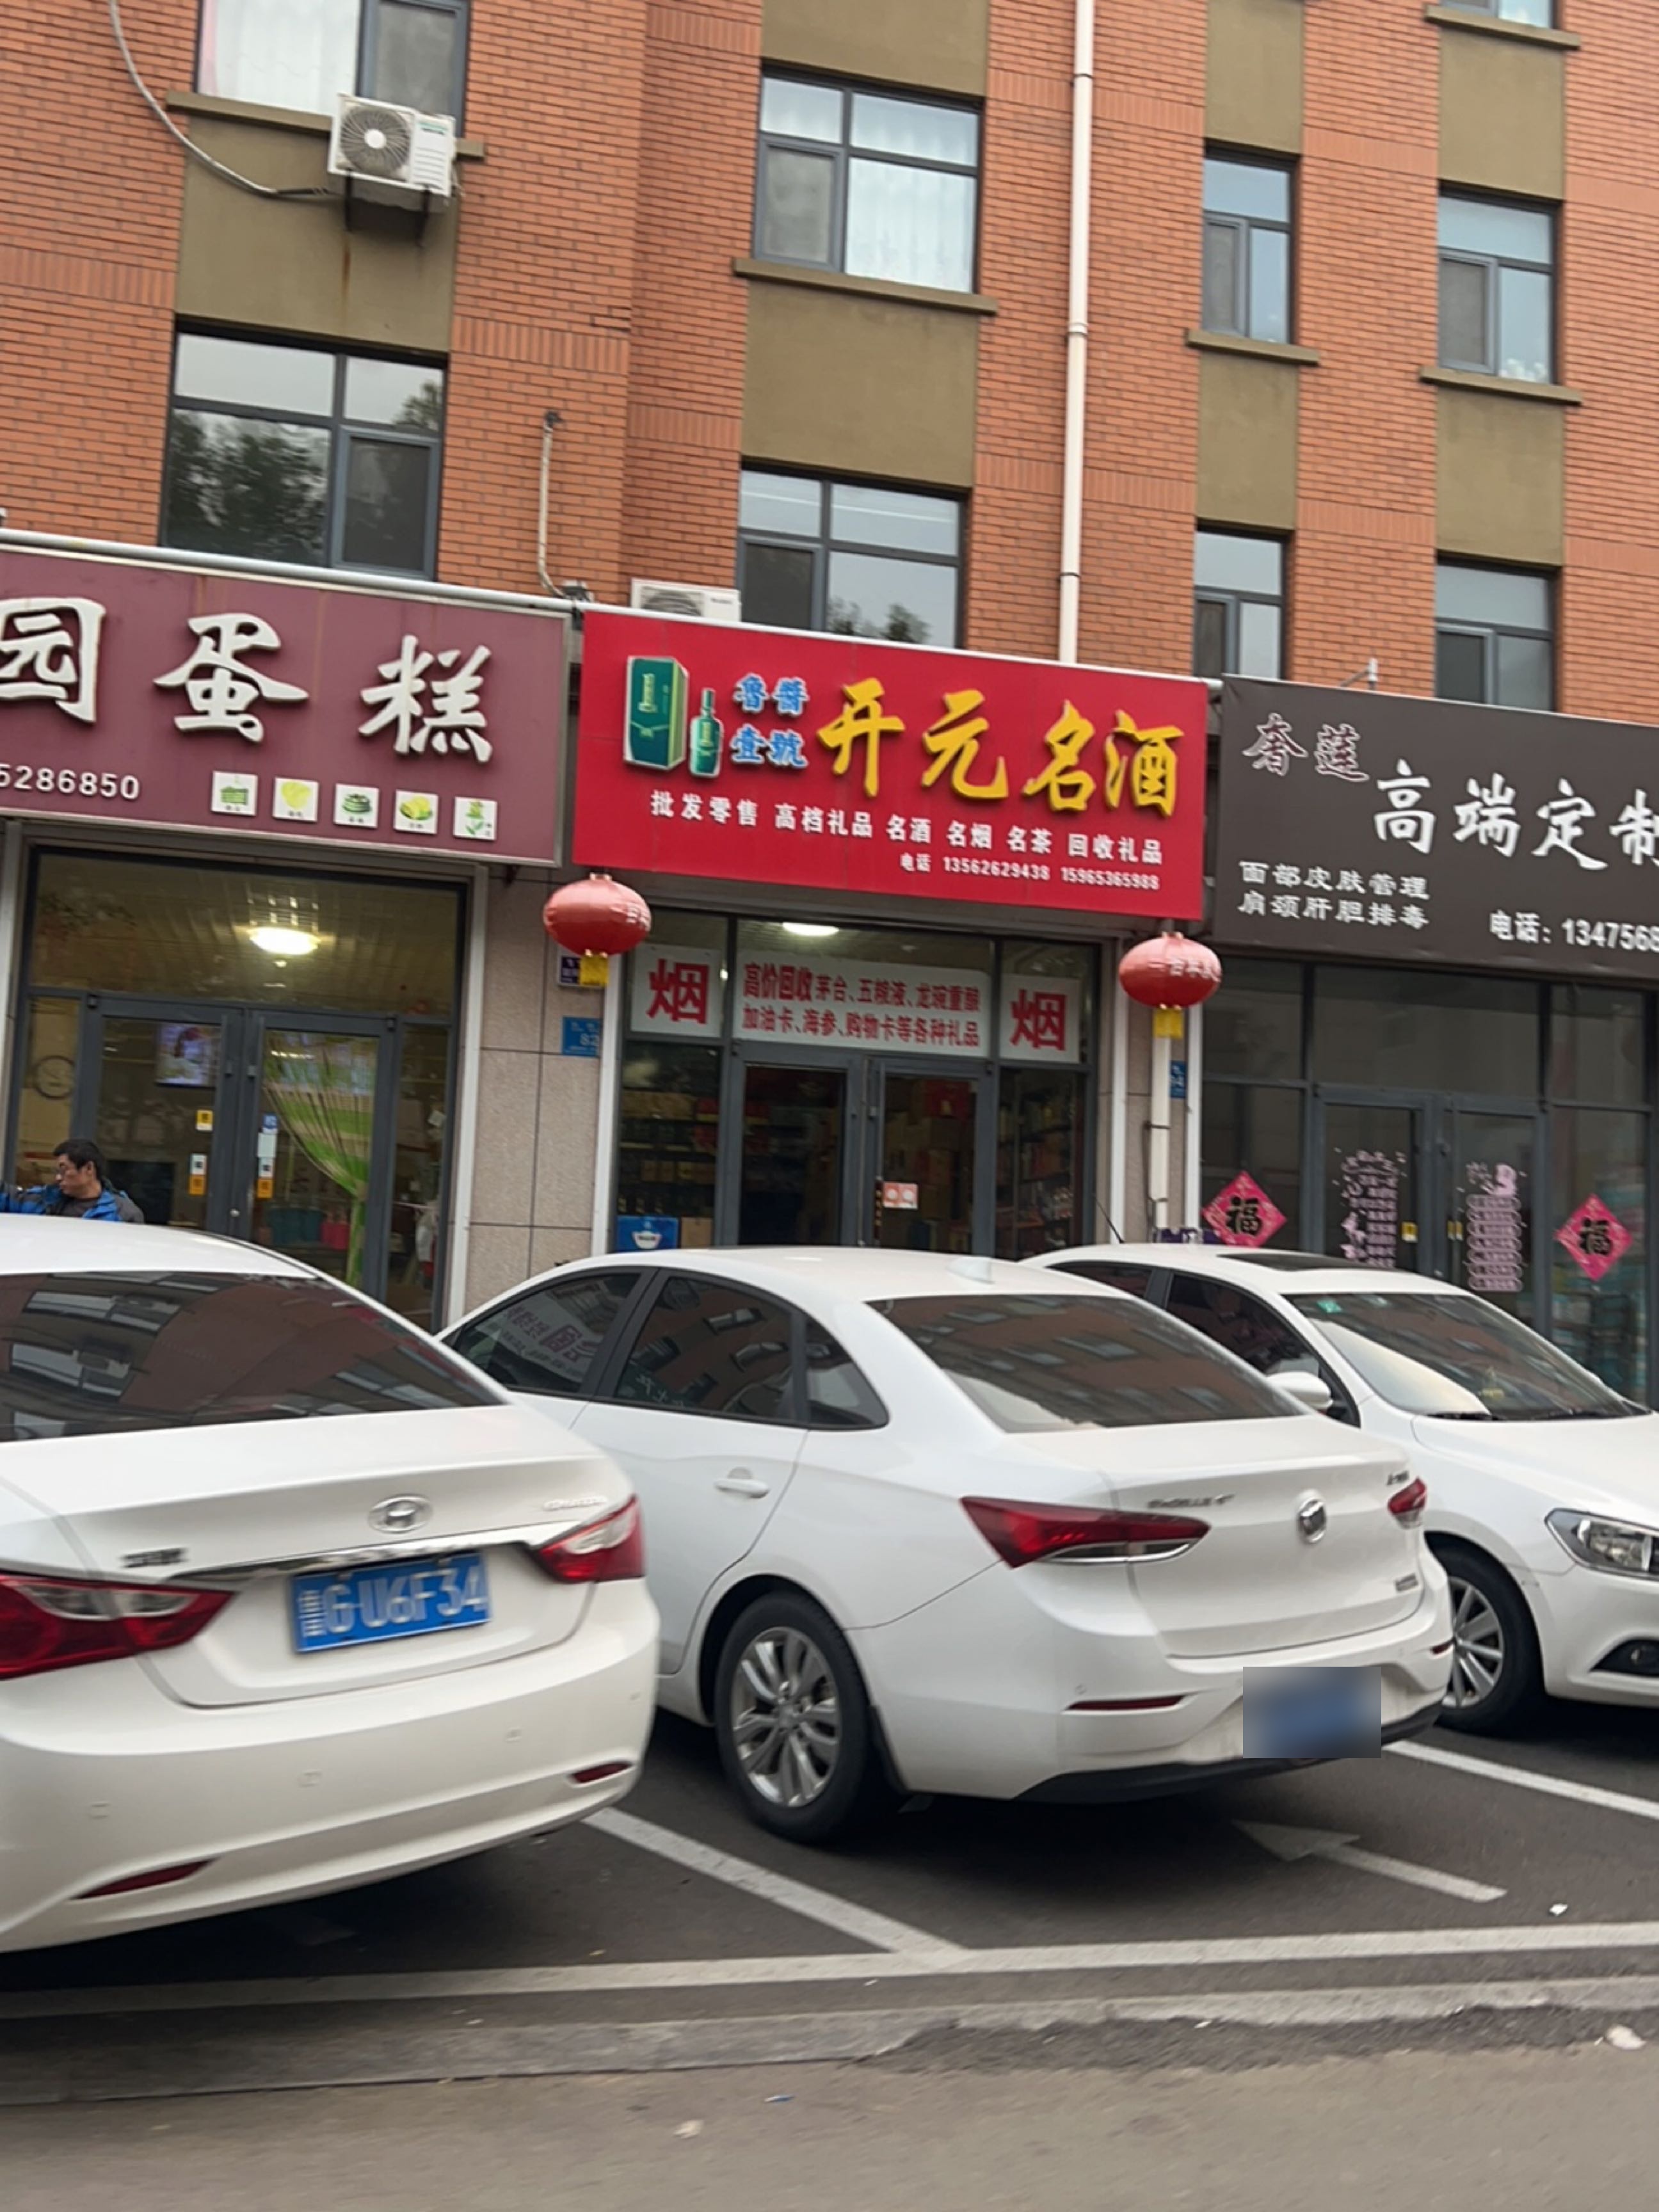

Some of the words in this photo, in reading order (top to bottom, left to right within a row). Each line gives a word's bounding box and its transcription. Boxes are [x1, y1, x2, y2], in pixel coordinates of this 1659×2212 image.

[817, 677, 1185, 817] 开元名酒
[650, 790, 757, 826] 批发零售
[774, 803, 872, 838] 高档礼品
[886, 814, 931, 844] 名酒
[946, 820, 992, 849] 名烟
[1006, 825, 1052, 854] 名茶
[1068, 833, 1162, 865] 回收礼品
[1374, 759, 1659, 870] 高端定制
[899, 853, 931, 872] 电话
[1239, 861, 1430, 900] 面部皮肤管理
[1237, 890, 1429, 929] 肩颈肝胆排毒
[646, 959, 709, 1025] 烟
[1010, 989, 1067, 1051] 烟
